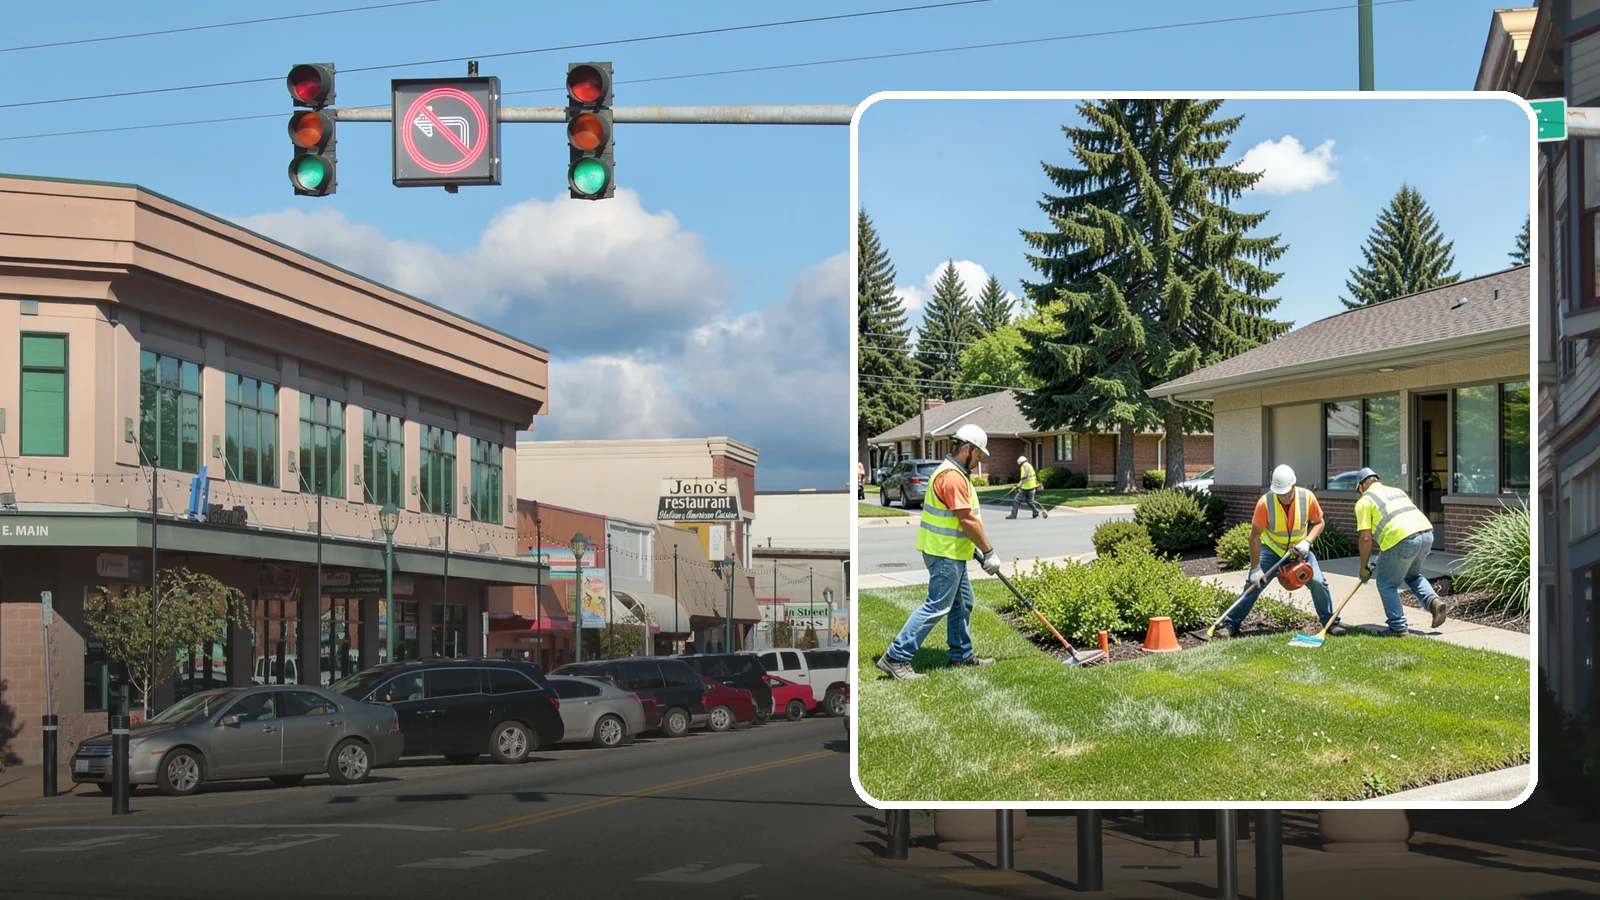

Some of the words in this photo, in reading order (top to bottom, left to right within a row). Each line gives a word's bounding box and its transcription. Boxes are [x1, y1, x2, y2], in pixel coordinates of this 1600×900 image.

[670, 480, 727, 494] Jeno's
[665, 497, 731, 509] restaurant
[686, 510, 714, 519] American
[715, 510, 737, 519] Cuisine
[2, 525, 13, 536] E.
[15, 525, 49, 536] MAIN
[797, 608, 828, 616] Street
